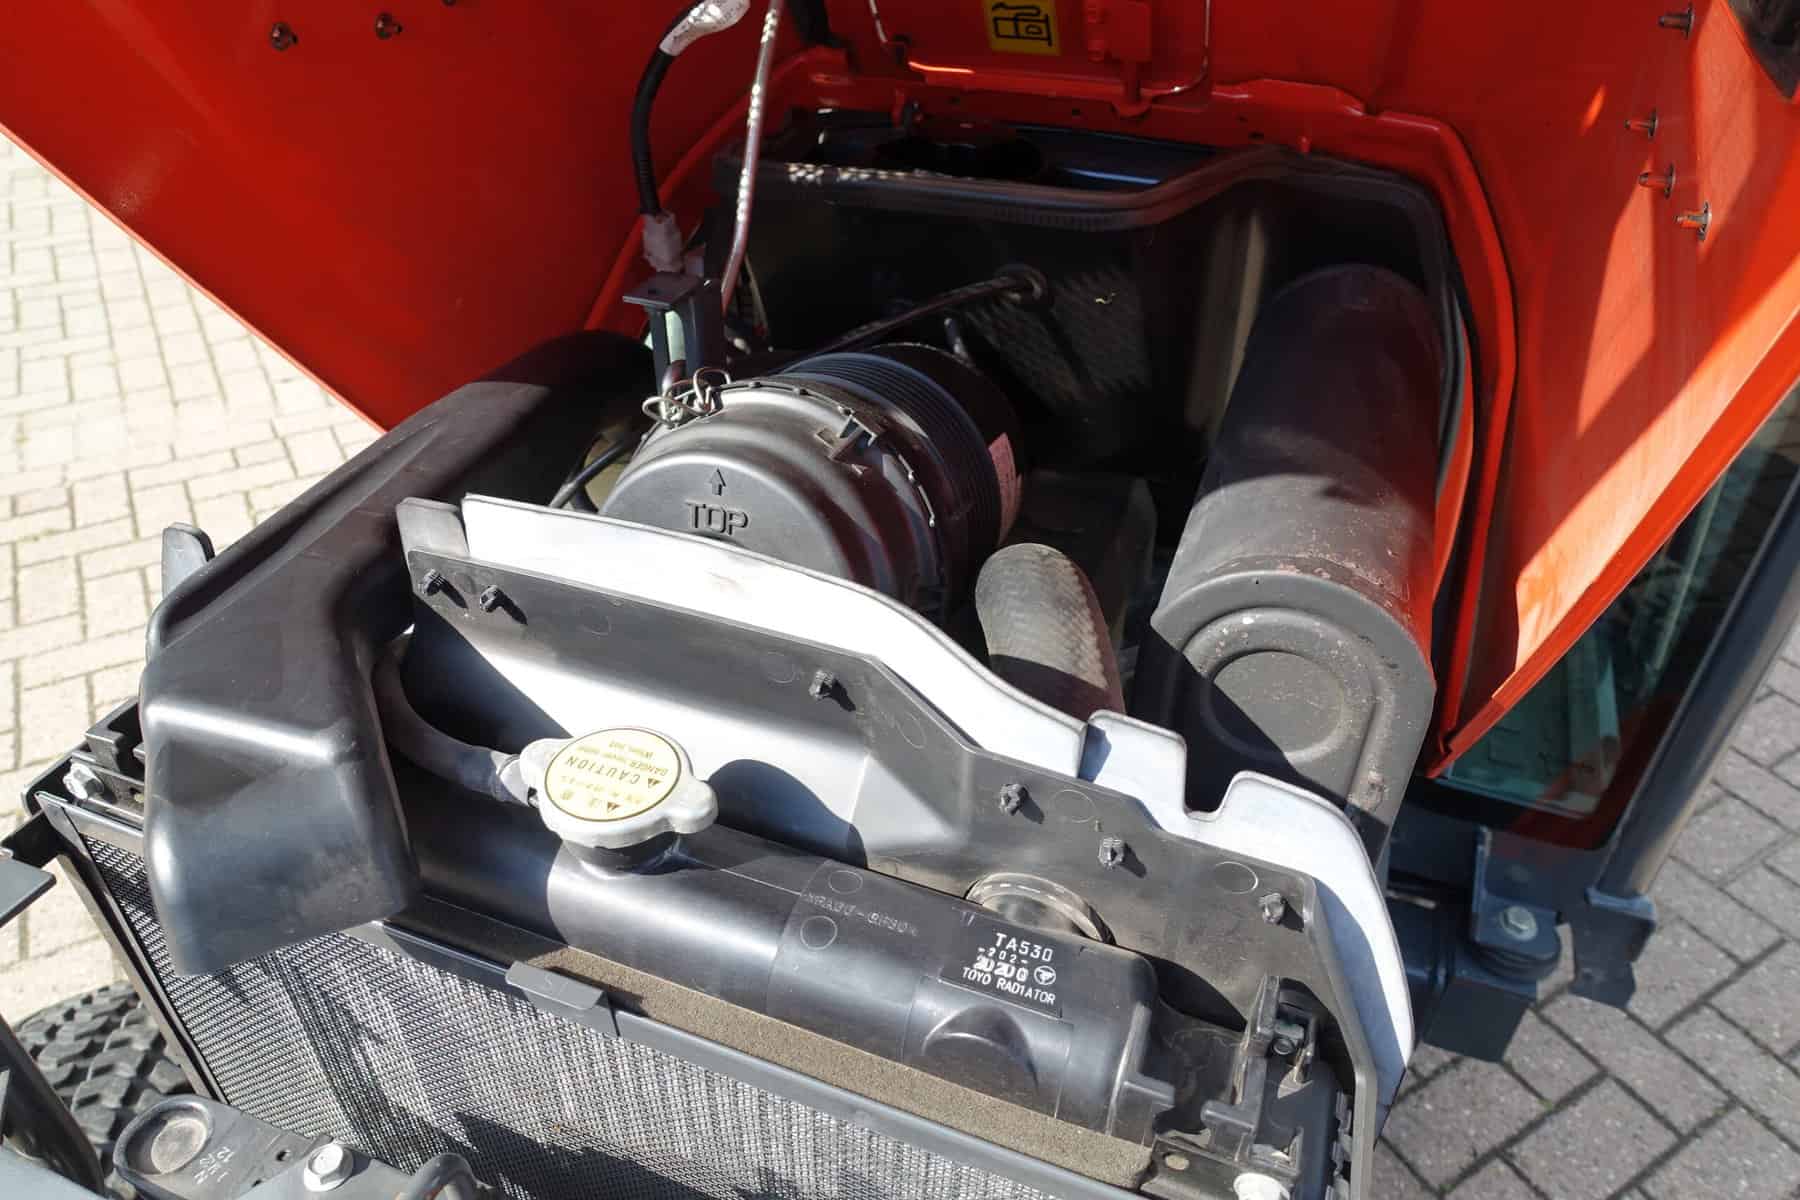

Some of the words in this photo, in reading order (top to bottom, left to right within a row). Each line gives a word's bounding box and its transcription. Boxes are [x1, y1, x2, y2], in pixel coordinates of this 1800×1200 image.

[687, 501, 749, 536] TOP
[566, 755, 641, 784] CAUTION
[995, 932, 1053, 962] TA530
[962, 966, 992, 985] TOYO
